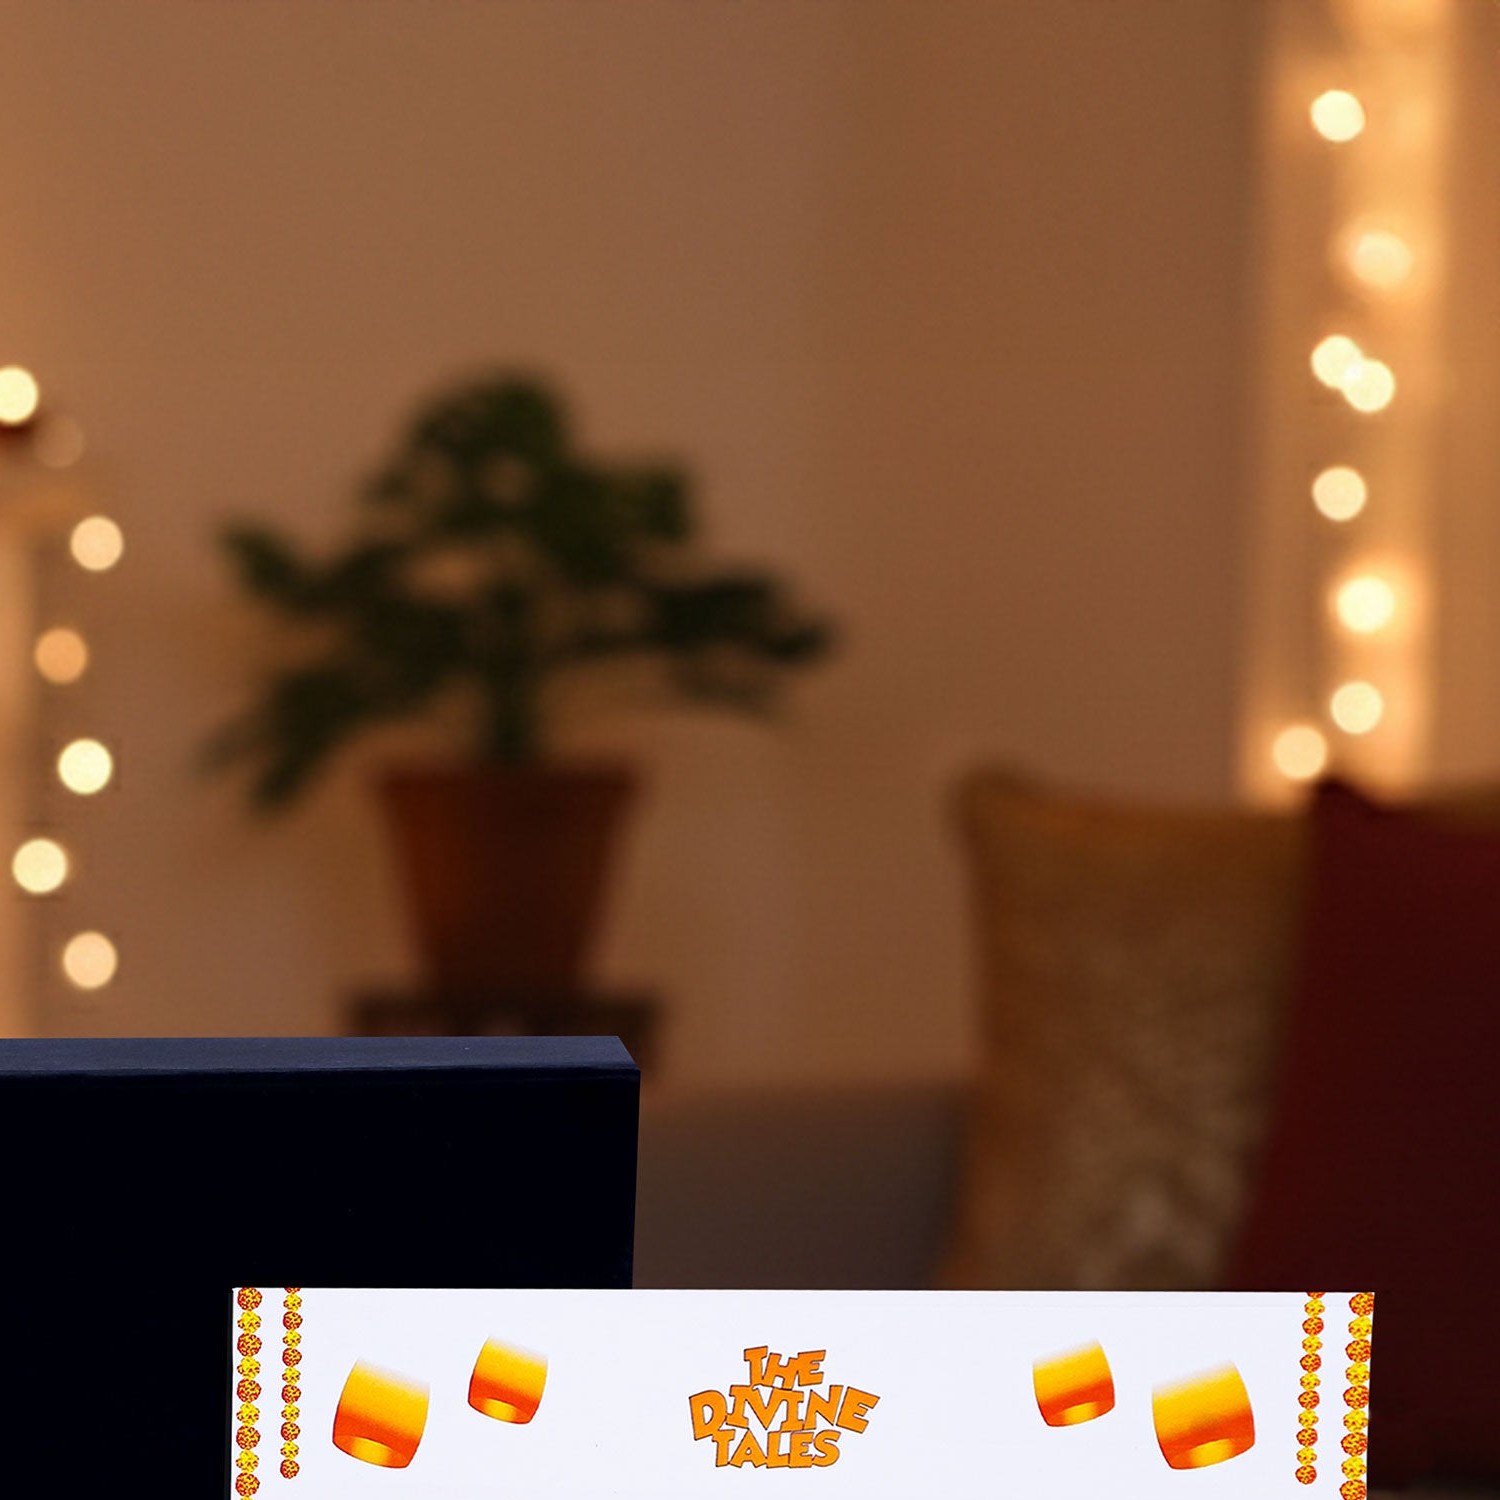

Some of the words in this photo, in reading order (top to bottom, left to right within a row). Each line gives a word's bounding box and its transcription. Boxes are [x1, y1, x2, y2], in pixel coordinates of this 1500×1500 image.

[743, 1345, 826, 1391] THE
[688, 1384, 881, 1441] DIVINE
[712, 1429, 842, 1469] TALES
